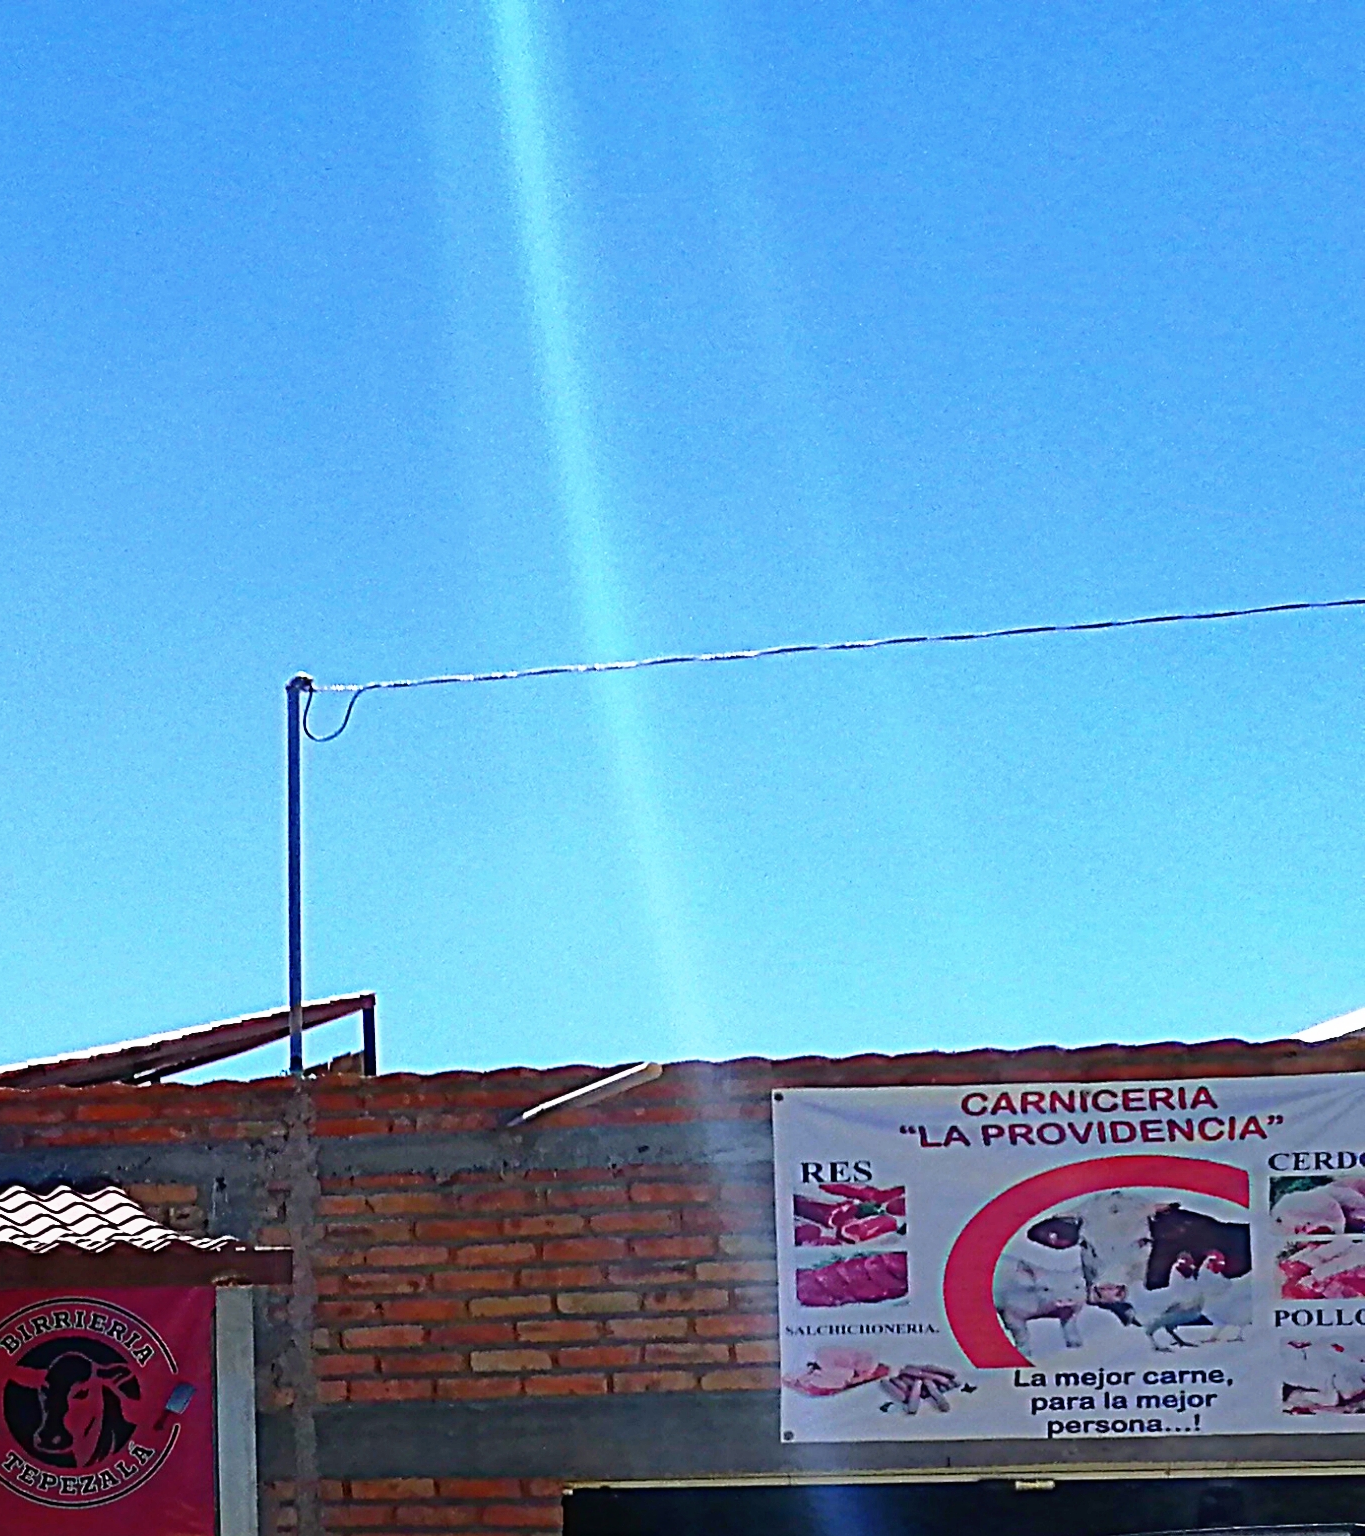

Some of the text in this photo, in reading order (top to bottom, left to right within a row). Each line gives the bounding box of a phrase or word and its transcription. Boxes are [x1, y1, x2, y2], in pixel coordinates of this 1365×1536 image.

[961, 1086, 1218, 1117] CARNICERIA
[801, 1160, 873, 1184] RES
[1268, 1150, 1365, 1172] CERD
[1014, 1367, 1234, 1391] La mejor carne,
[1031, 1390, 1218, 1415] para la mejor
[1047, 1414, 1201, 1439] persona...!
[1, 1440, 156, 1496] TEPEZALÁ
